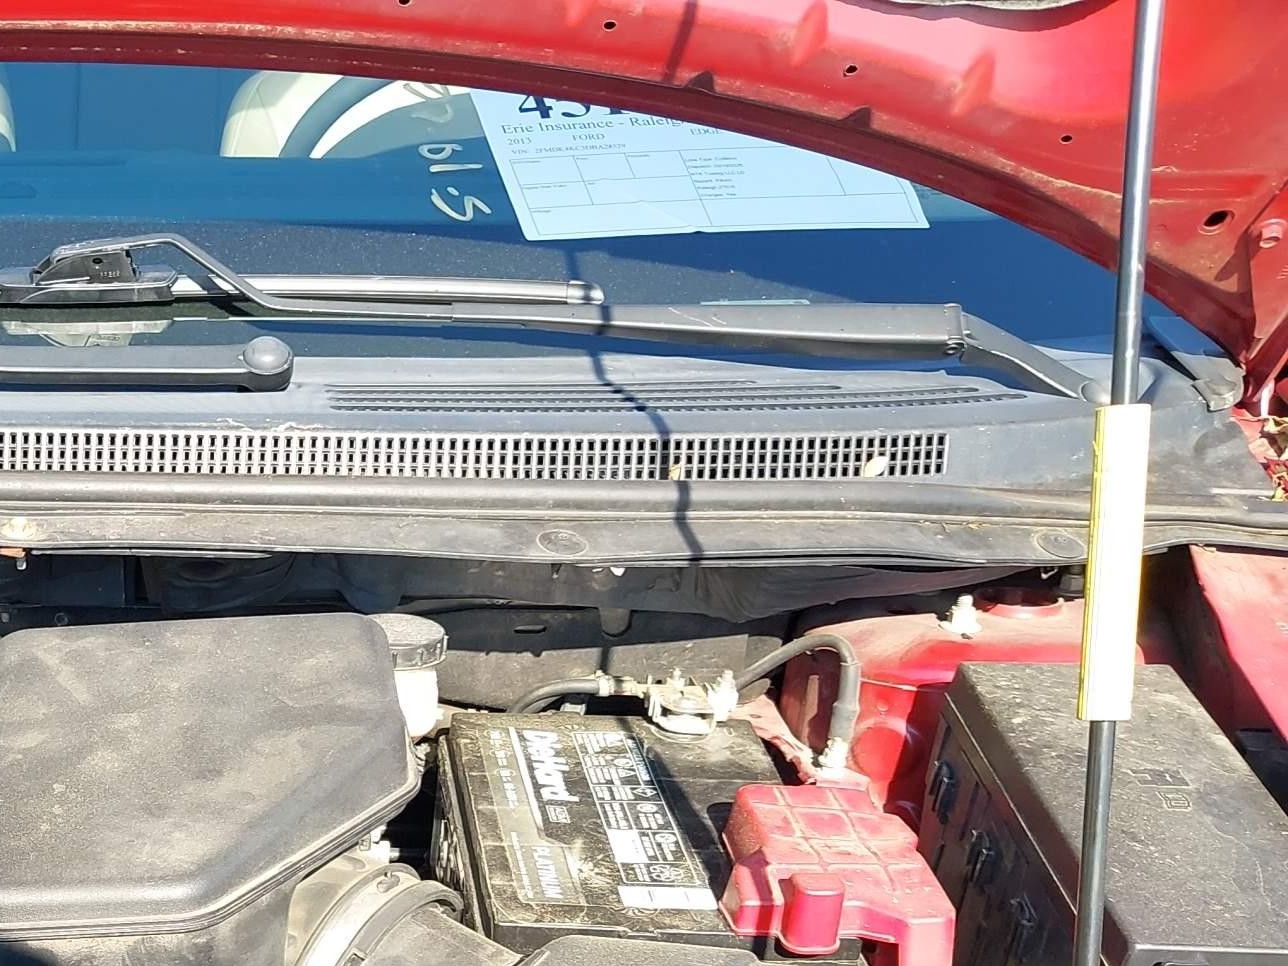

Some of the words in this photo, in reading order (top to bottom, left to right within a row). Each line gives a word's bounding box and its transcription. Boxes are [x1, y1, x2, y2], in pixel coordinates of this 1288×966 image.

[501, 123, 534, 134] Erie
[538, 119, 613, 133] Insurance
[506, 137, 532, 145] 2013
[572, 133, 605, 141] FORD
[522, 730, 579, 802] DieHard
[531, 846, 563, 899] PLATINUM
